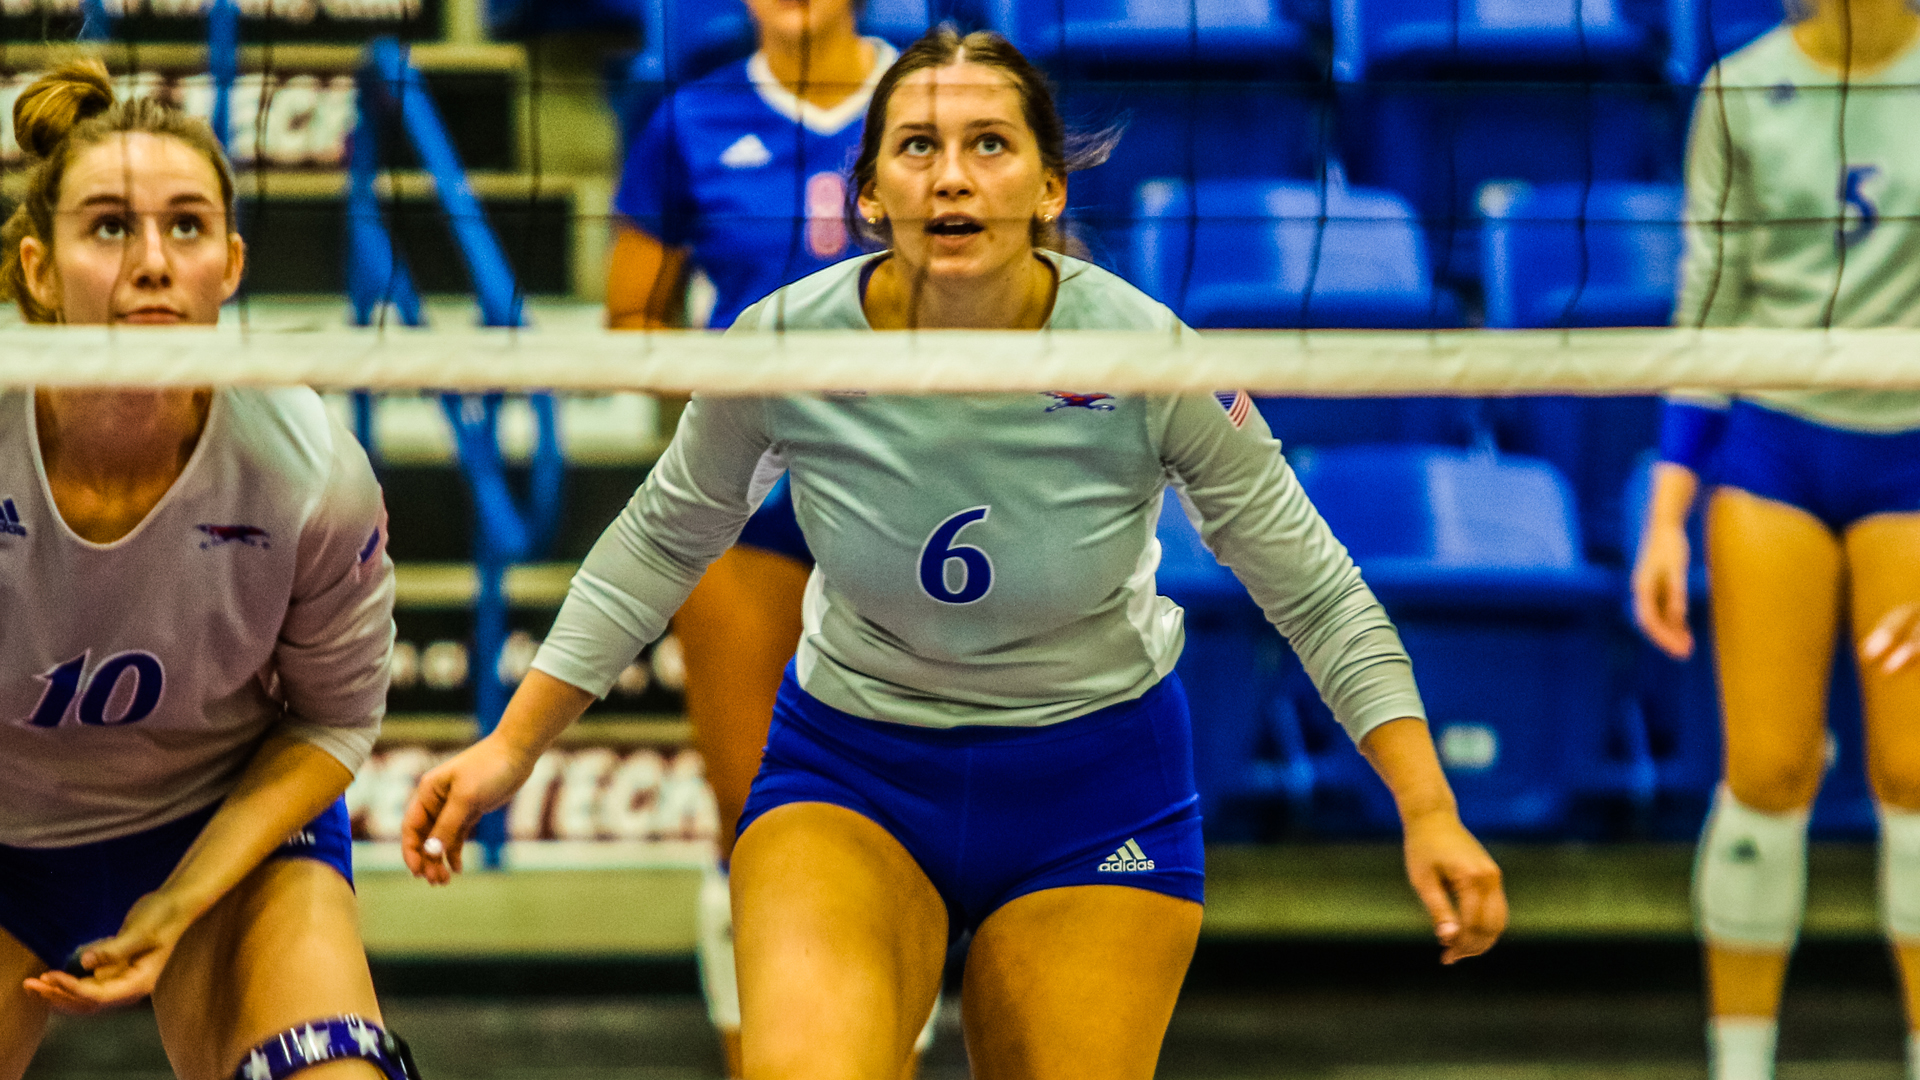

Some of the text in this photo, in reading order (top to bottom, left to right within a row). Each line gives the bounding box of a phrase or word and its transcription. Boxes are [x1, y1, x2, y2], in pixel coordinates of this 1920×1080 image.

[1836, 163, 1880, 251] 5
[917, 504, 994, 605] 6
[20, 648, 166, 729] 10
[1098, 858, 1156, 872] adidas
